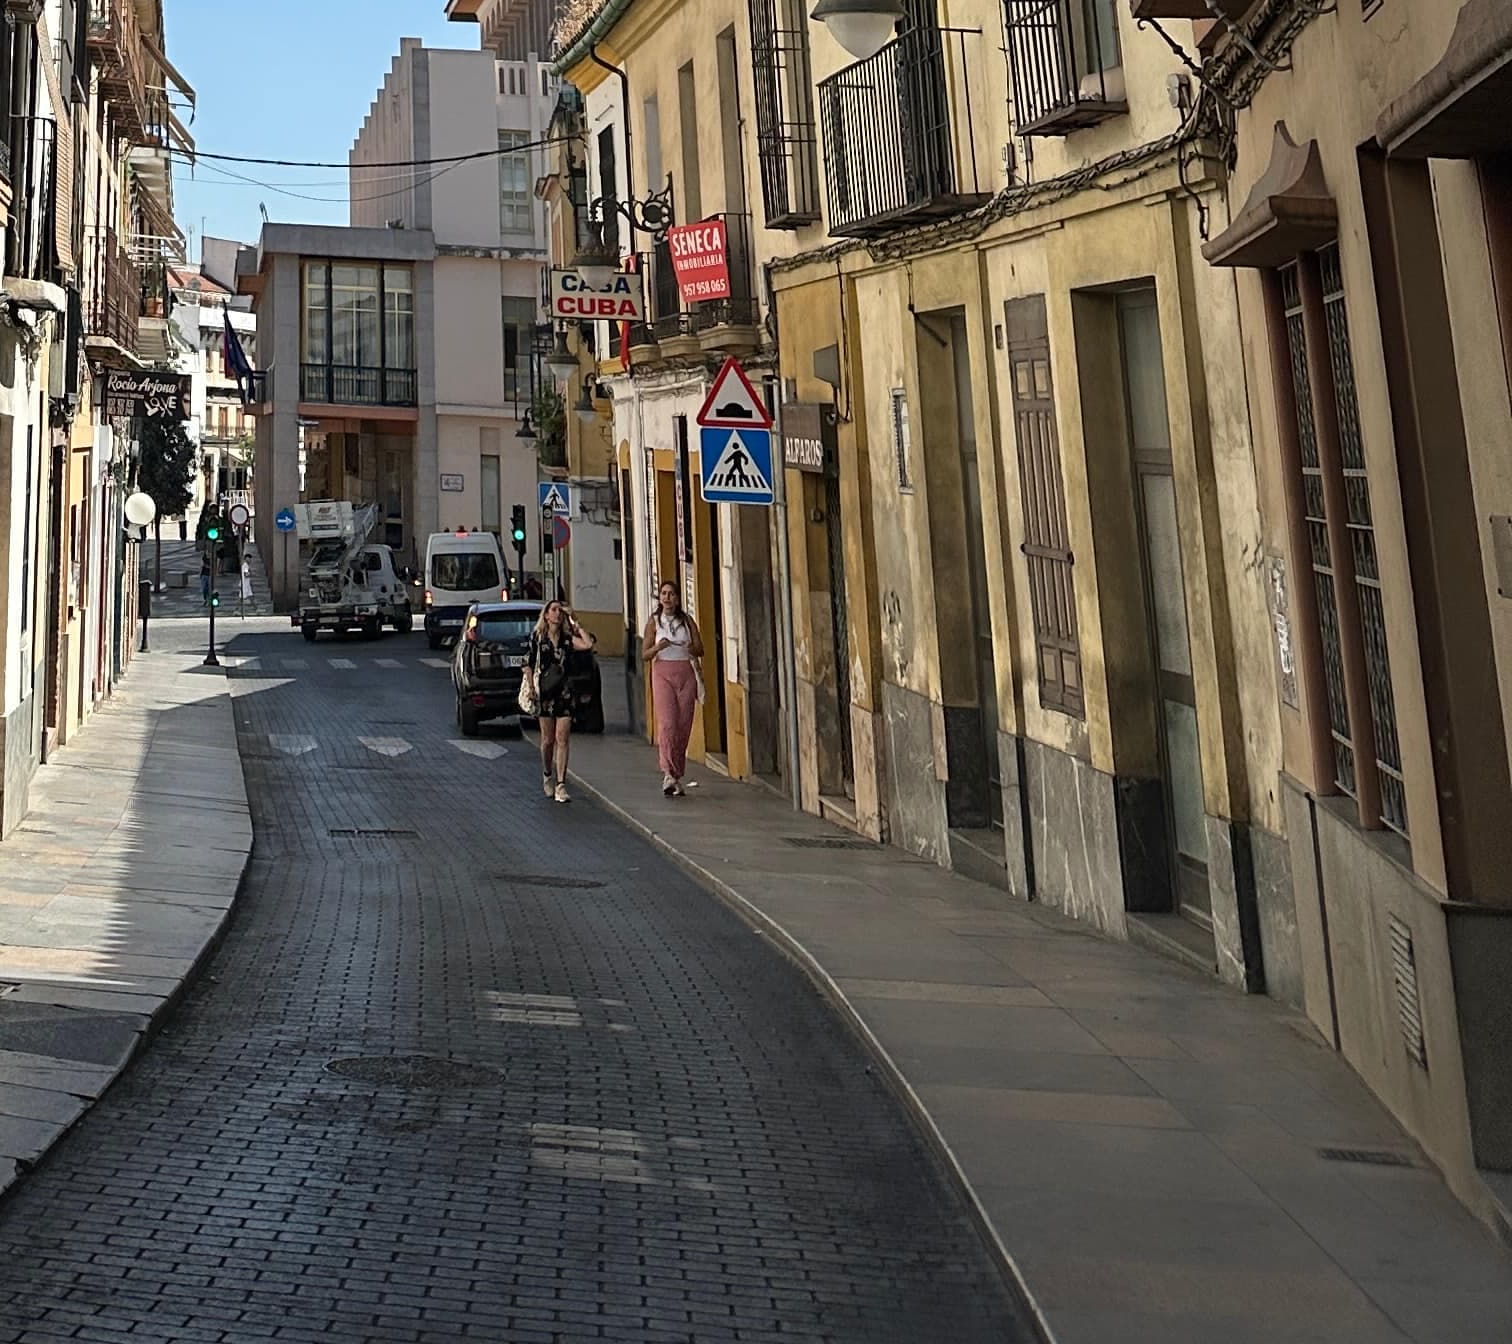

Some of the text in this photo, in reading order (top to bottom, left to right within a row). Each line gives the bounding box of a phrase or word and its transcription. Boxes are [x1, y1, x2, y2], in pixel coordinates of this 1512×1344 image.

[671, 227, 723, 257] SÉNECA
[683, 278, 726, 297] 957 958 065
[557, 296, 638, 316] CUBA
[137, 377, 178, 397] Arjona
[785, 437, 824, 467] ALFAROS
